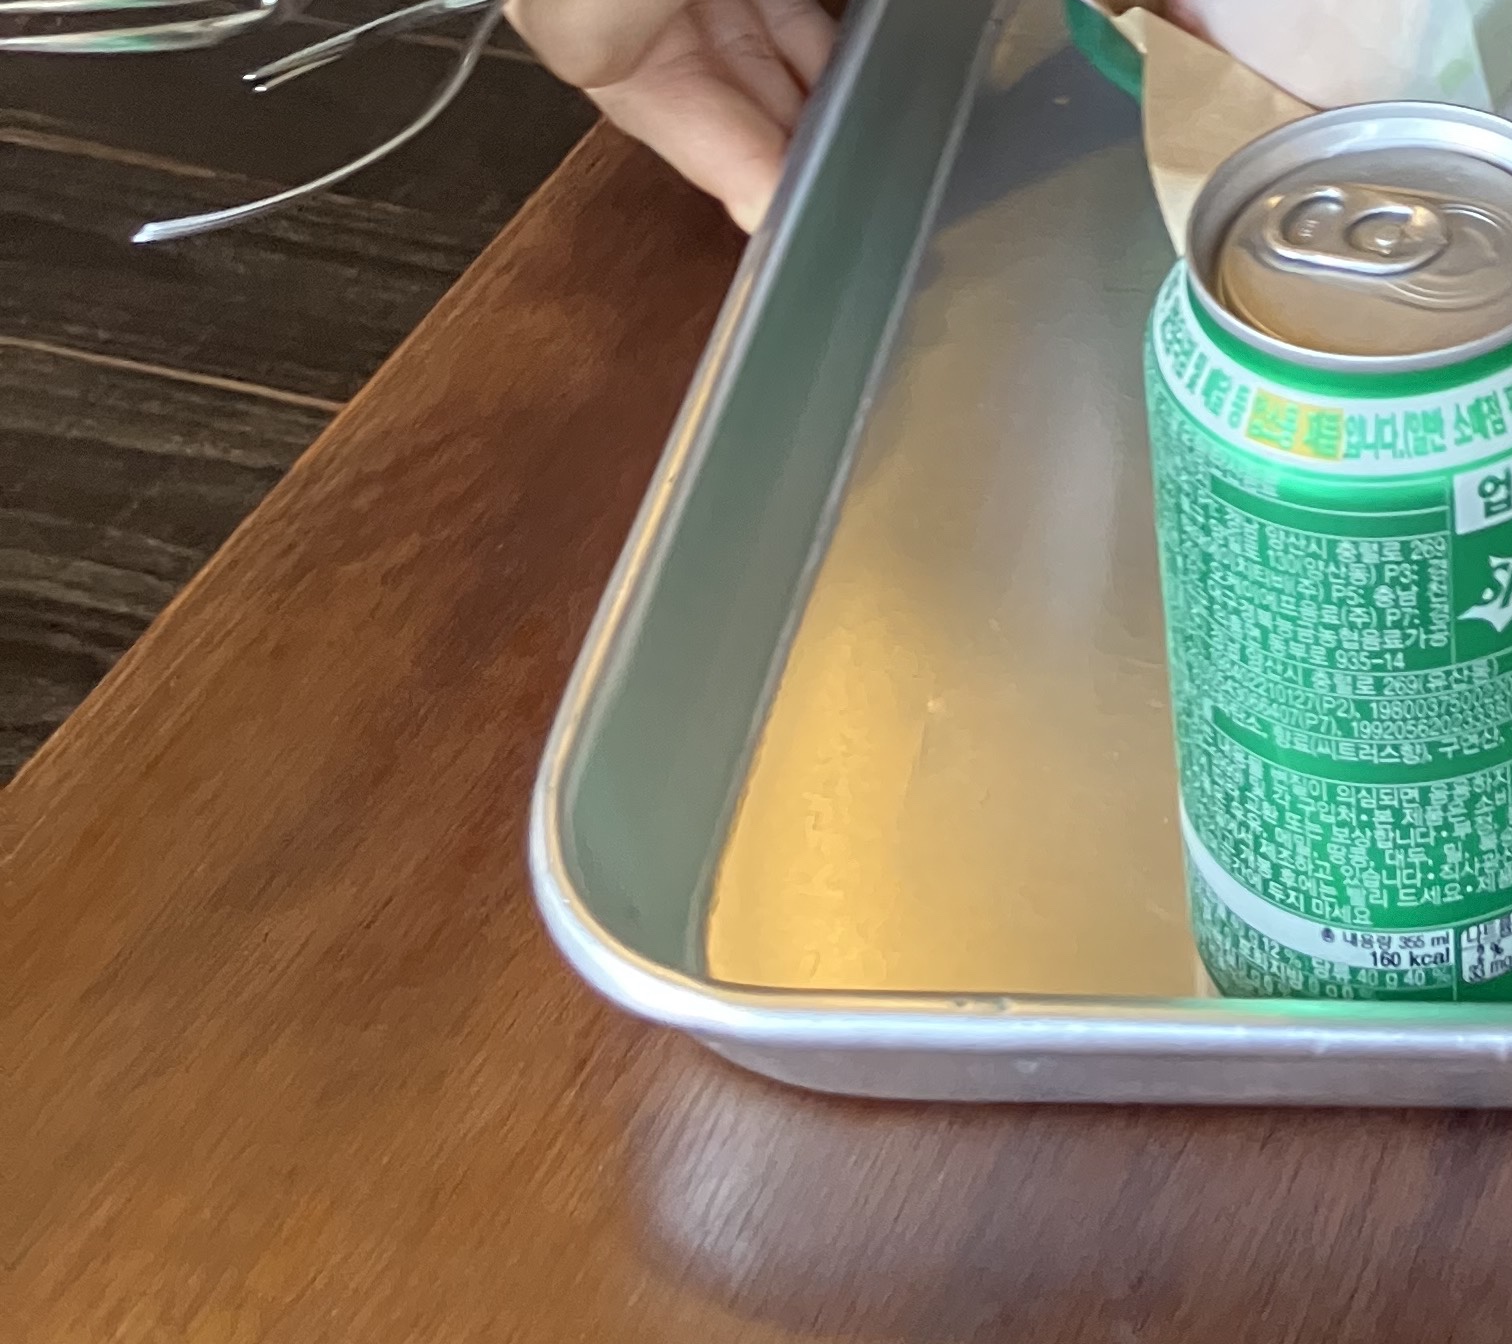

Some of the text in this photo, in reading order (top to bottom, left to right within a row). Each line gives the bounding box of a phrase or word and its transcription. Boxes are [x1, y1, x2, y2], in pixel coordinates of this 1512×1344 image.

[1335, 647, 1406, 672] 935-14
[1336, 783, 1419, 809] 의심되면
[1268, 878, 1304, 912] 두지
[1311, 896, 1372, 925] 마세요
[1430, 931, 1449, 947] ml
[1370, 946, 1449, 967] 160 kcal
[1357, 968, 1378, 986] 40
